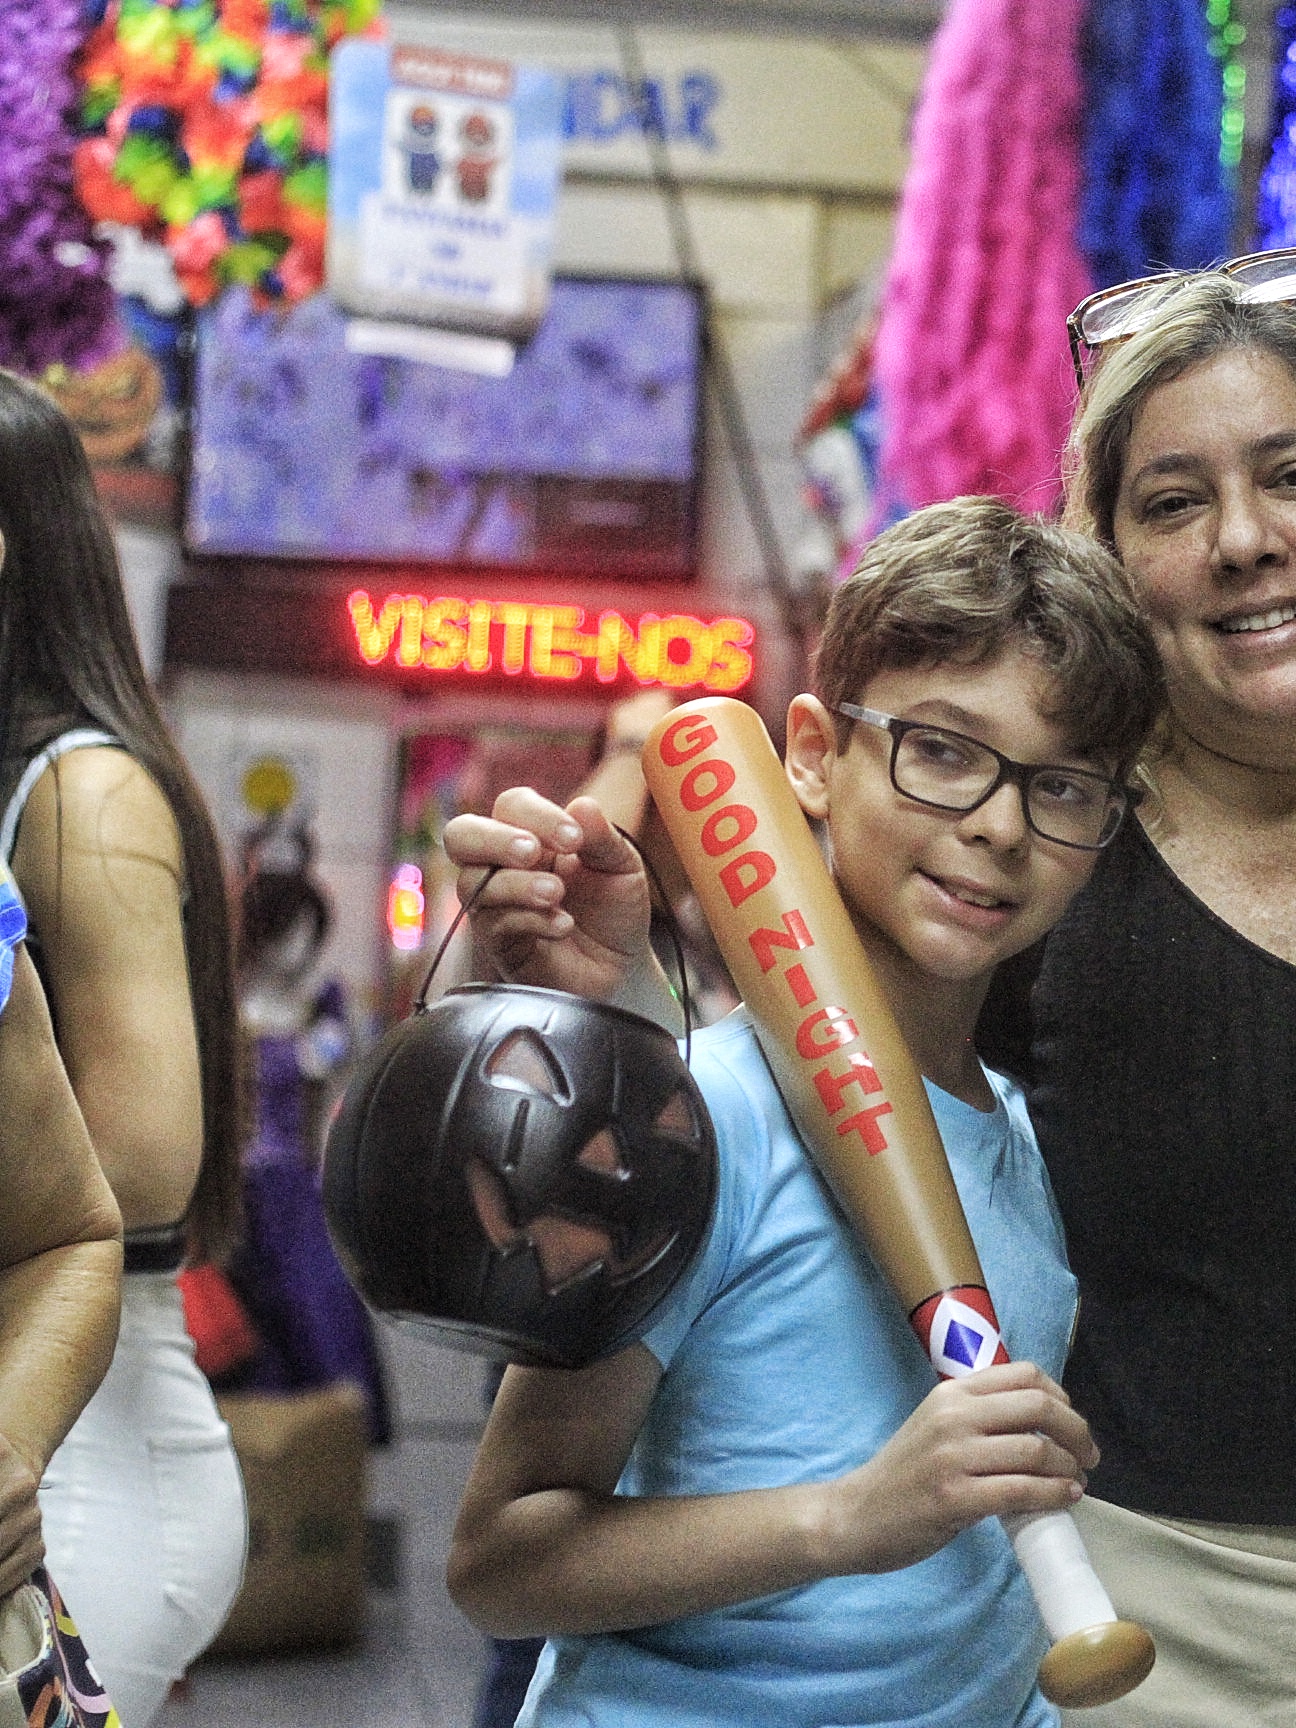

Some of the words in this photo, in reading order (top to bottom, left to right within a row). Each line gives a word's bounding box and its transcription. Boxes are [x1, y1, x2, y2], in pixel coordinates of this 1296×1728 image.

[348, 590, 755, 692] VISITE-NOS
[659, 714, 777, 908] GOOD
[749, 909, 893, 1156] NIGHT
